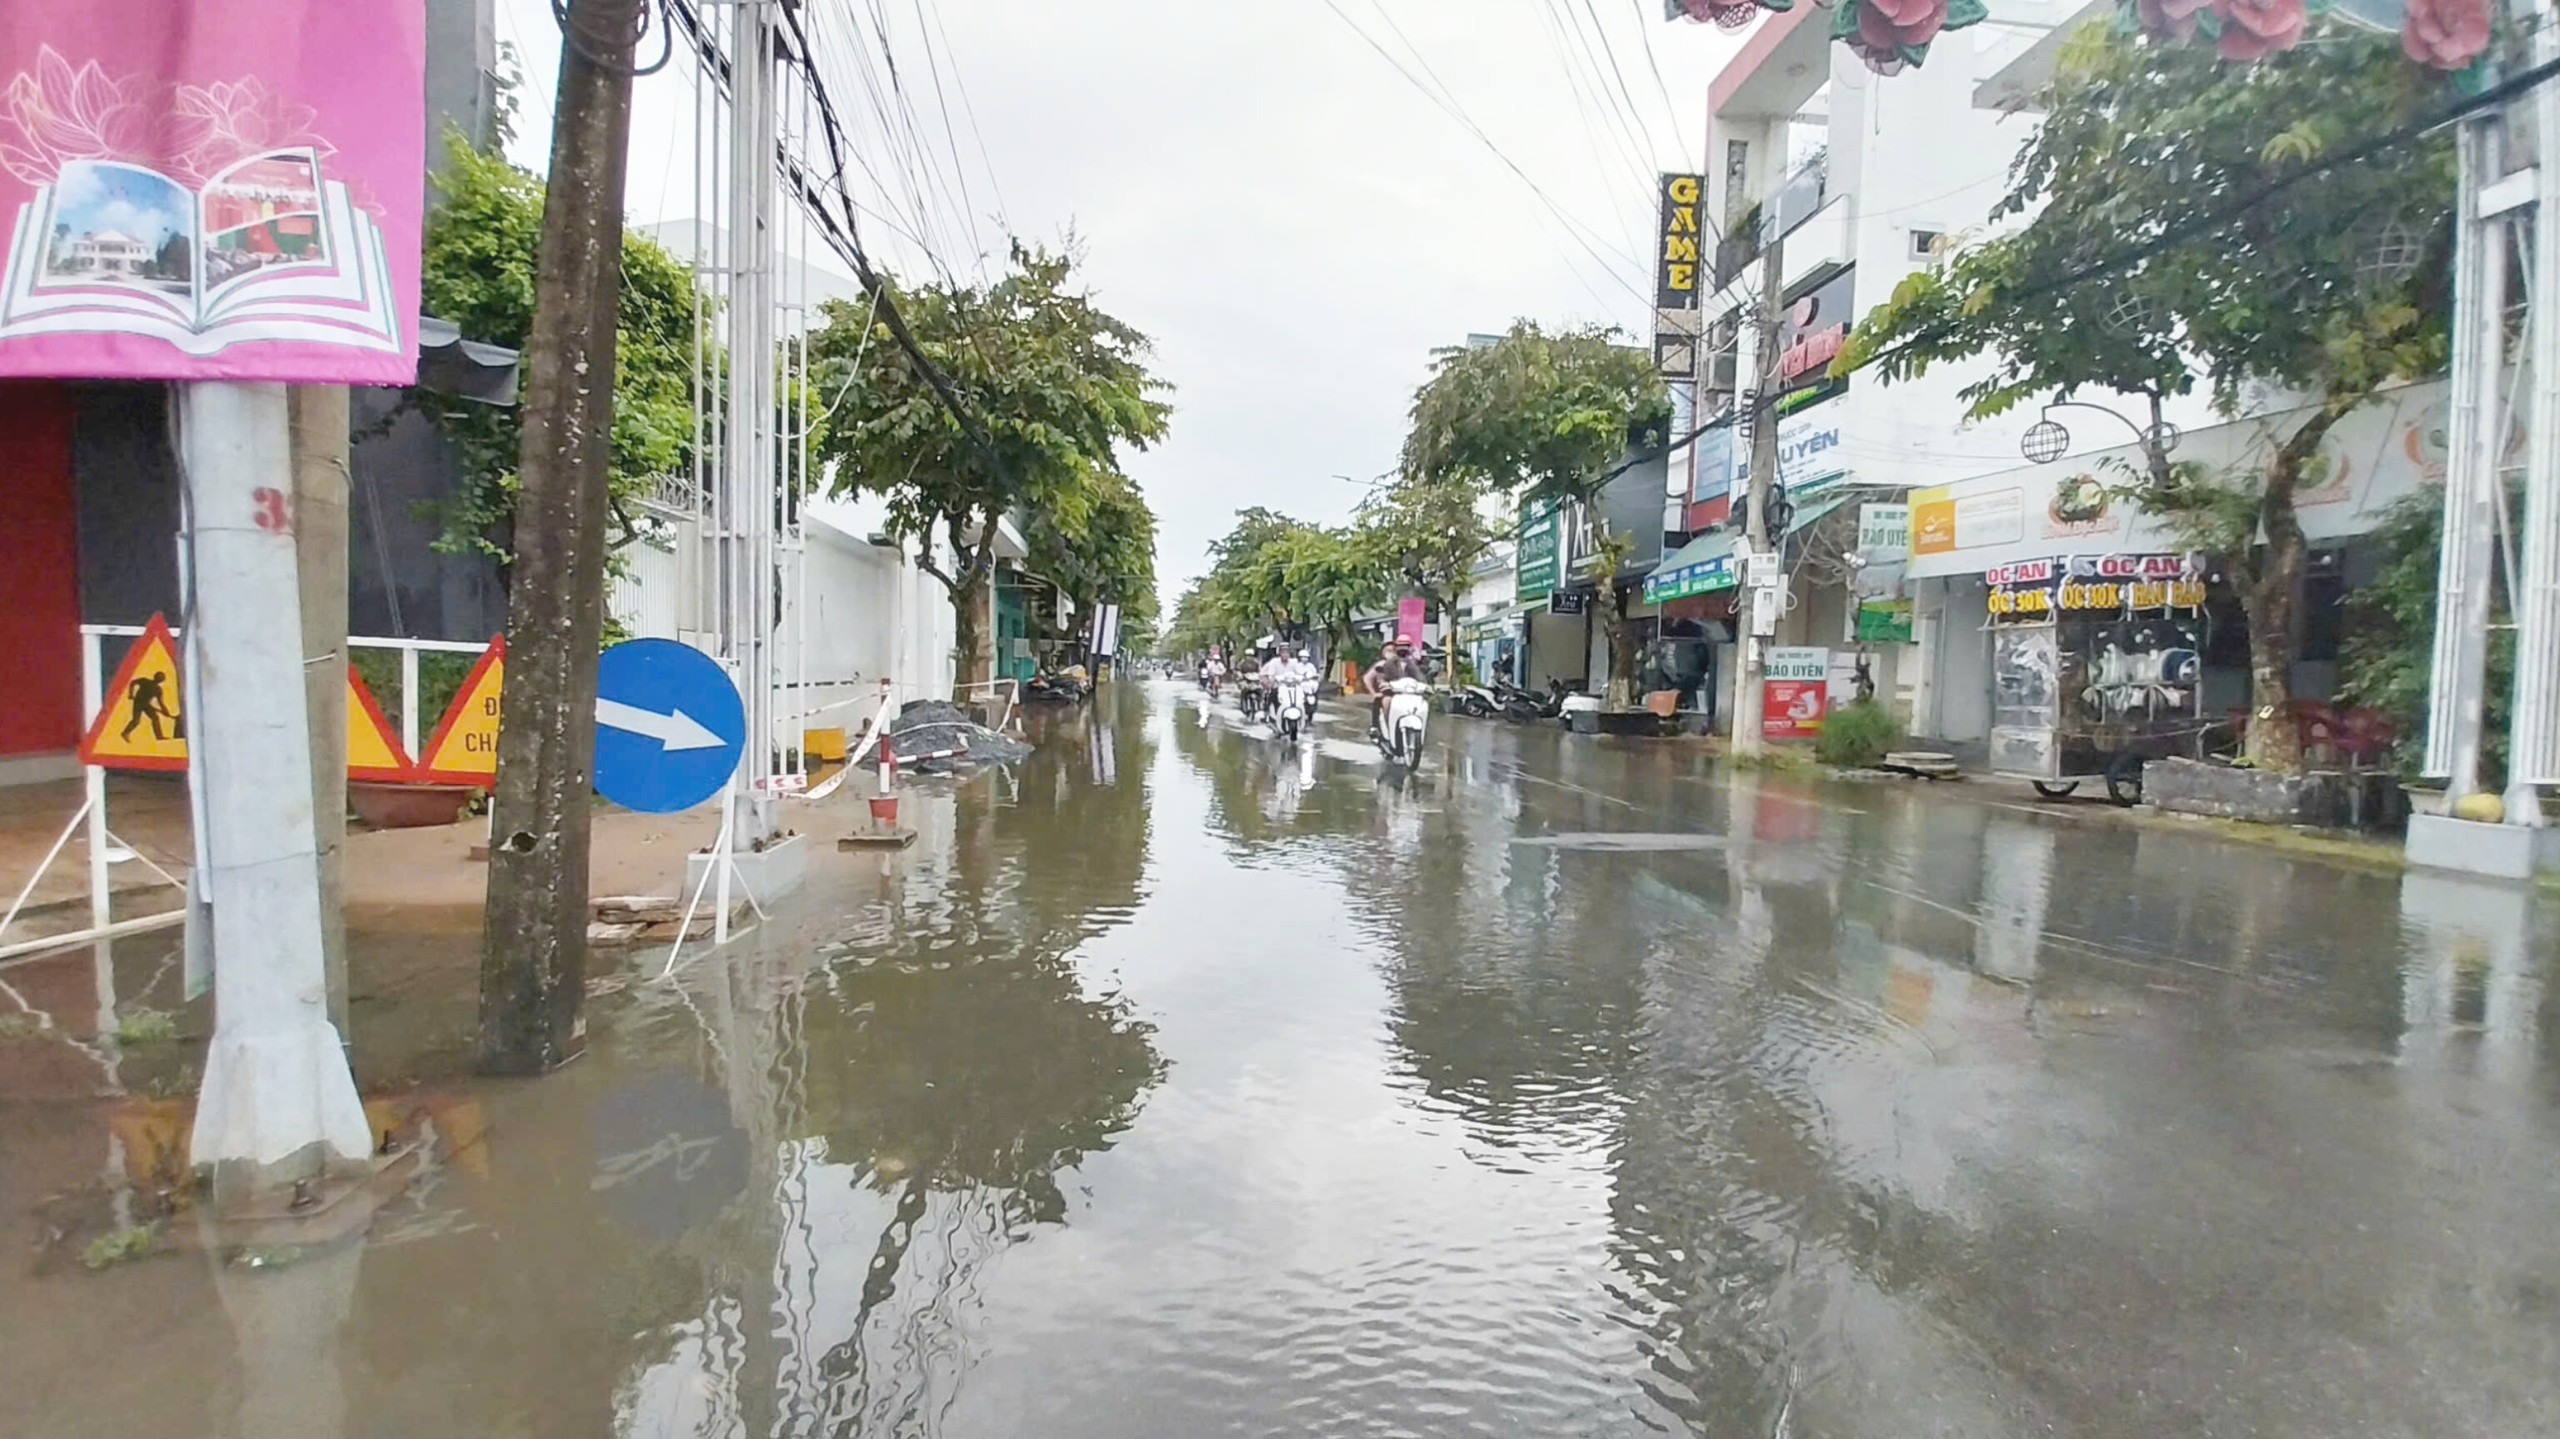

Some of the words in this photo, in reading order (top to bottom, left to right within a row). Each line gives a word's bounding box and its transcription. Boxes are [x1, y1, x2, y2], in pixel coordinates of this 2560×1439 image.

[1664, 177, 1699, 290] GAME
[1780, 427, 1839, 464] UYÊN
[251, 487, 287, 531] 3
[2016, 588, 2048, 613] 30K
[465, 732, 498, 752] CH
